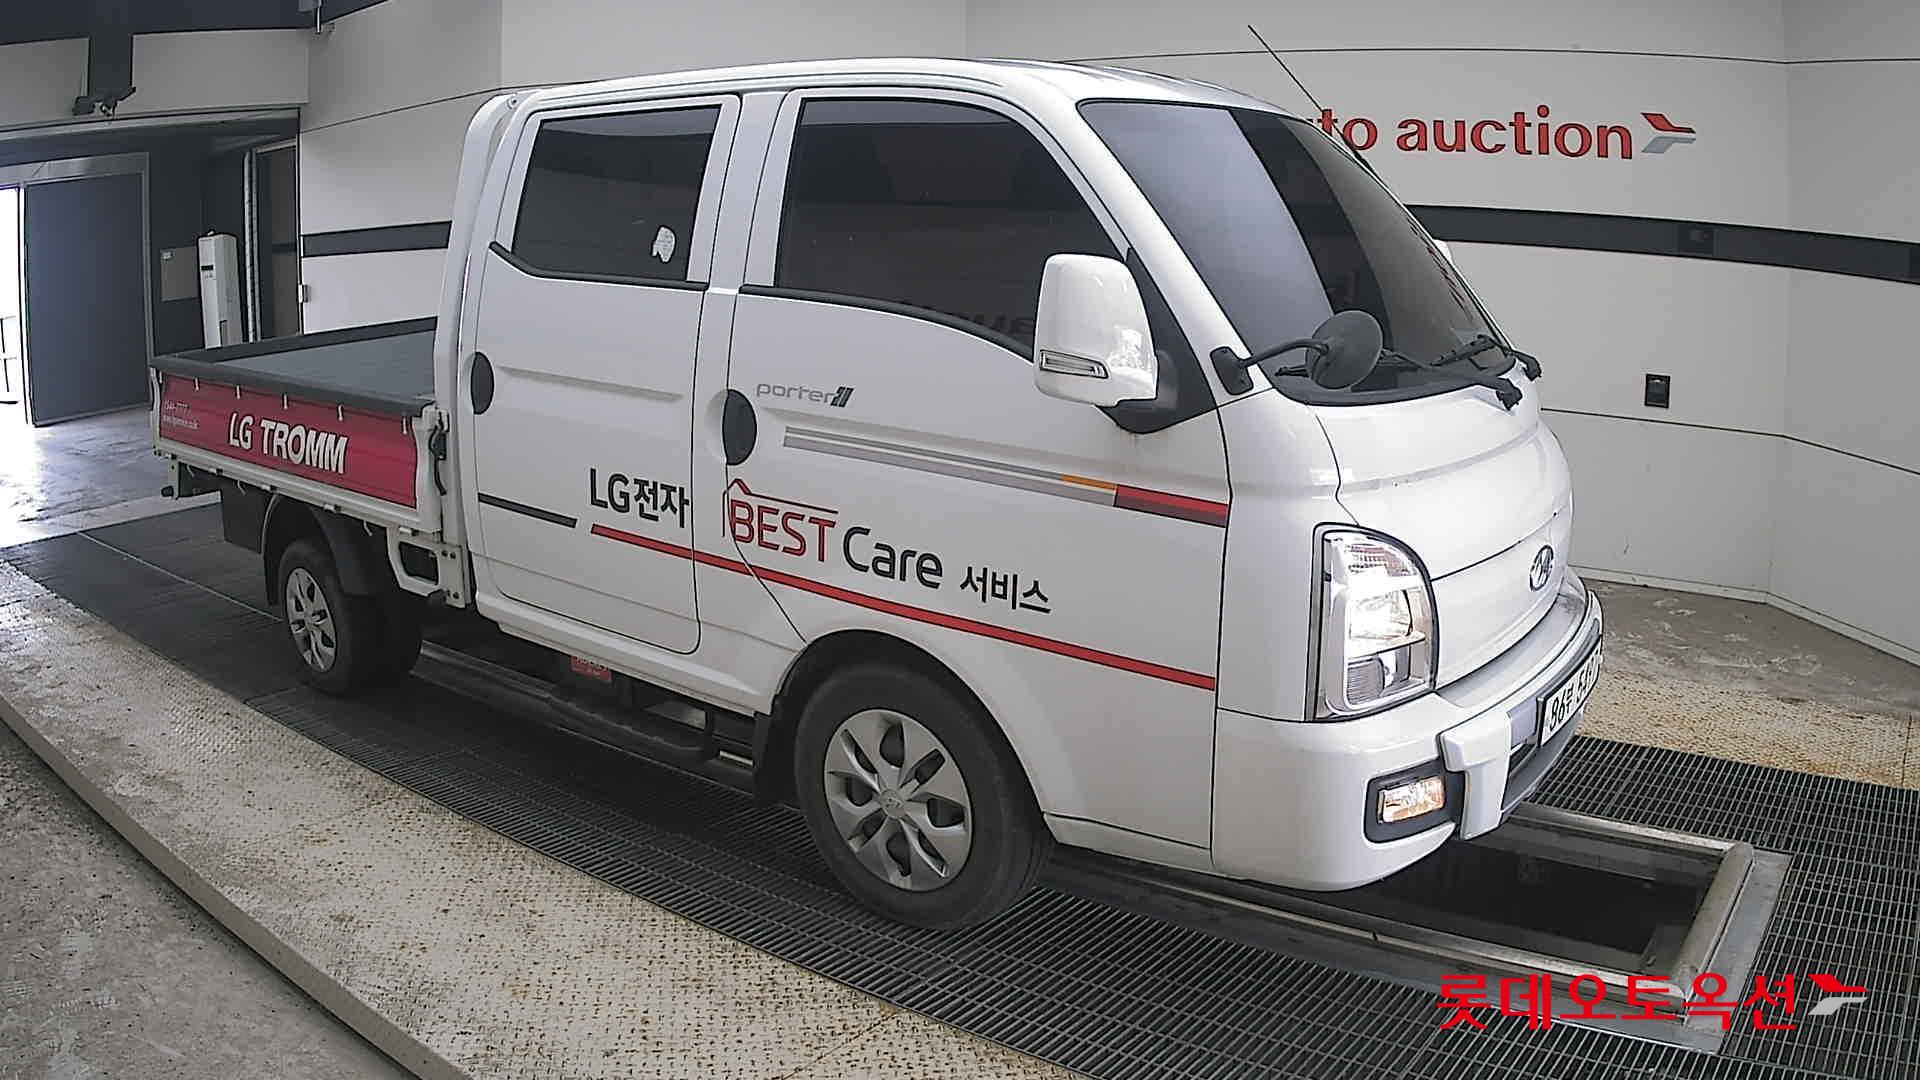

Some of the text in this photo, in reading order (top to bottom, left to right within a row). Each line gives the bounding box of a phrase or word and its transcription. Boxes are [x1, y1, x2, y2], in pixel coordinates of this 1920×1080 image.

[1308, 104, 1633, 161] to auction
[229, 412, 348, 475] LG TROMM
[589, 467, 1052, 614] LG전자 BEST Care 서비스
